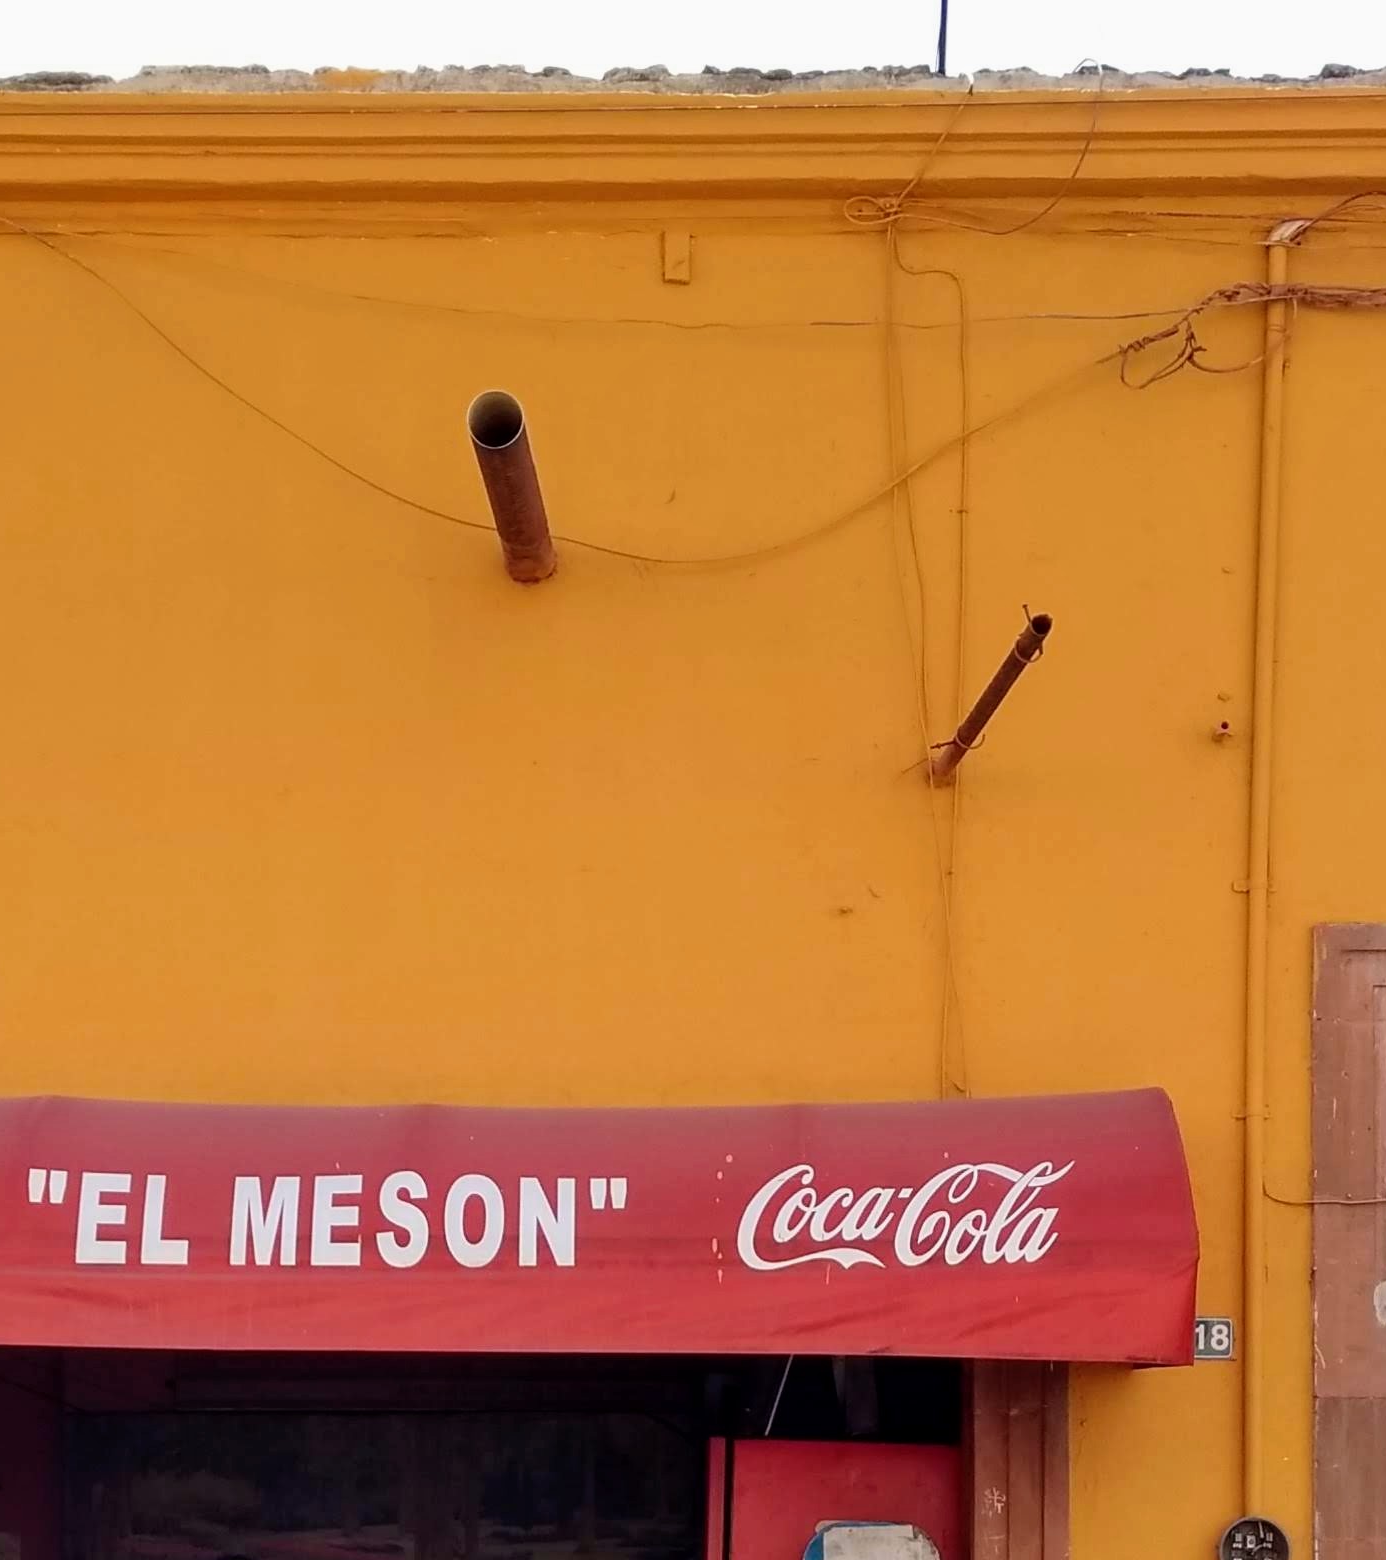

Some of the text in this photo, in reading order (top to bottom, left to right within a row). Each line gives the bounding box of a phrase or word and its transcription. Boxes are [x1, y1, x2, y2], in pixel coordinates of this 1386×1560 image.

[27, 1168, 189, 1266] "EL
[228, 1170, 628, 1269] MESON"
[736, 1160, 1076, 1271] Coca-Cola
[1194, 1323, 1230, 1352] 18
